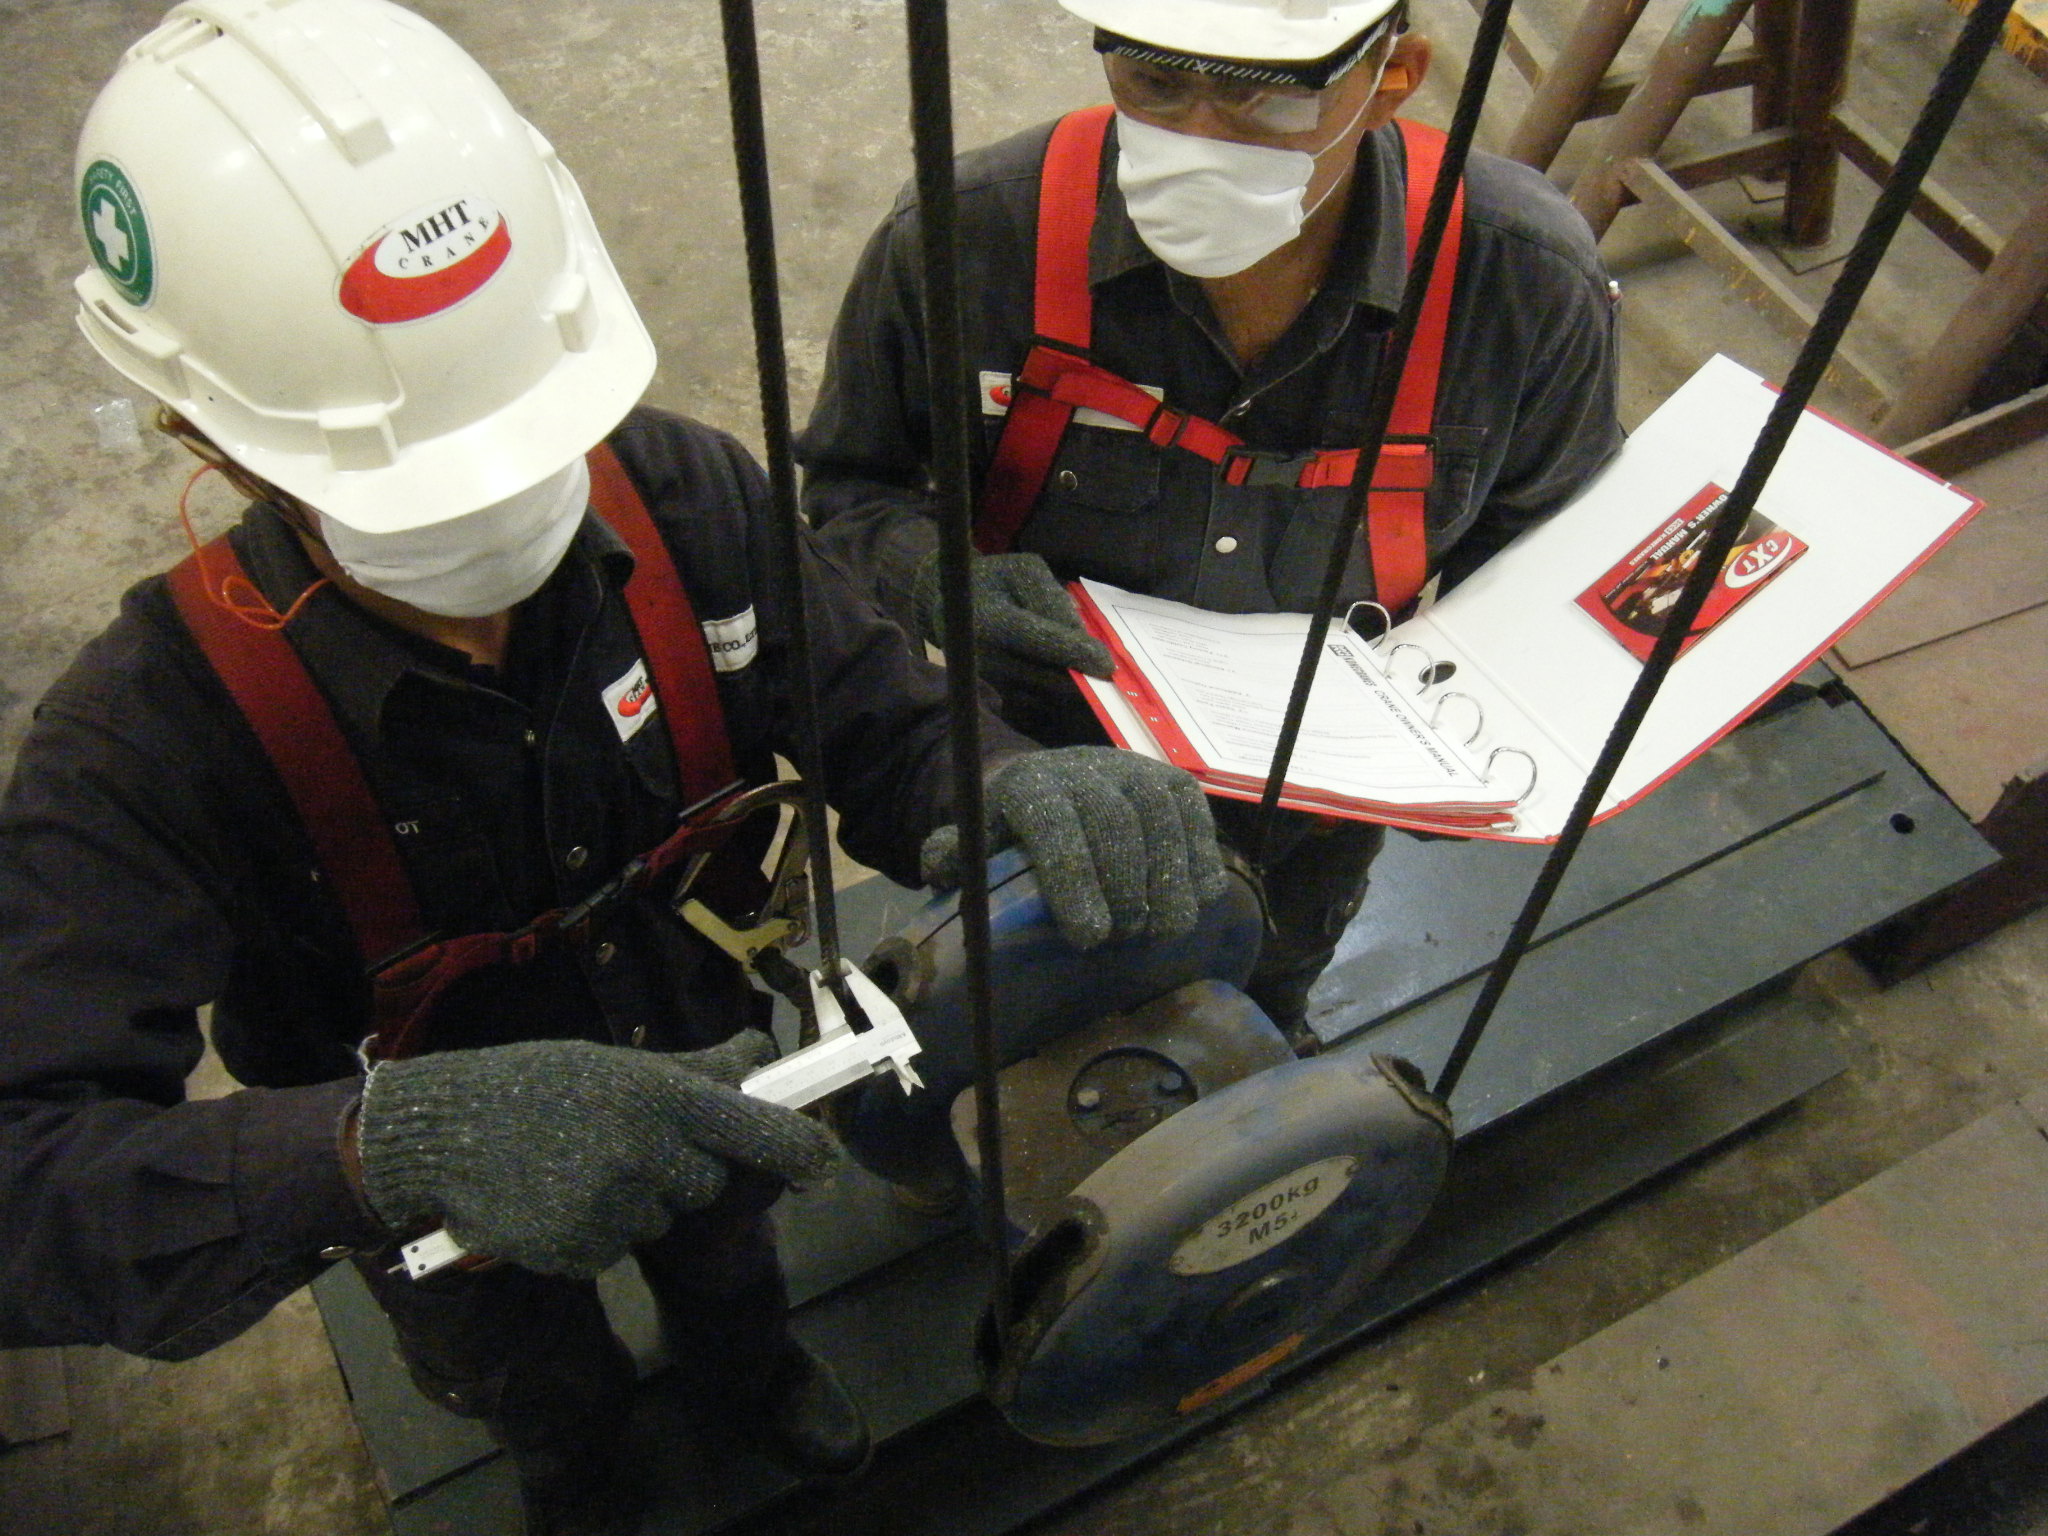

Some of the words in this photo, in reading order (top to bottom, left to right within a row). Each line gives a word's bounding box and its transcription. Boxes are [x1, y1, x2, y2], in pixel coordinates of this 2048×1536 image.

[398, 215, 490, 270] CRANE
[400, 199, 471, 253] MHT
[1687, 493, 1728, 530] OWNER'S
[1649, 528, 1688, 561] MANUAL
[1743, 538, 1780, 574] CXT
[1427, 747, 1459, 777] MANUAL
